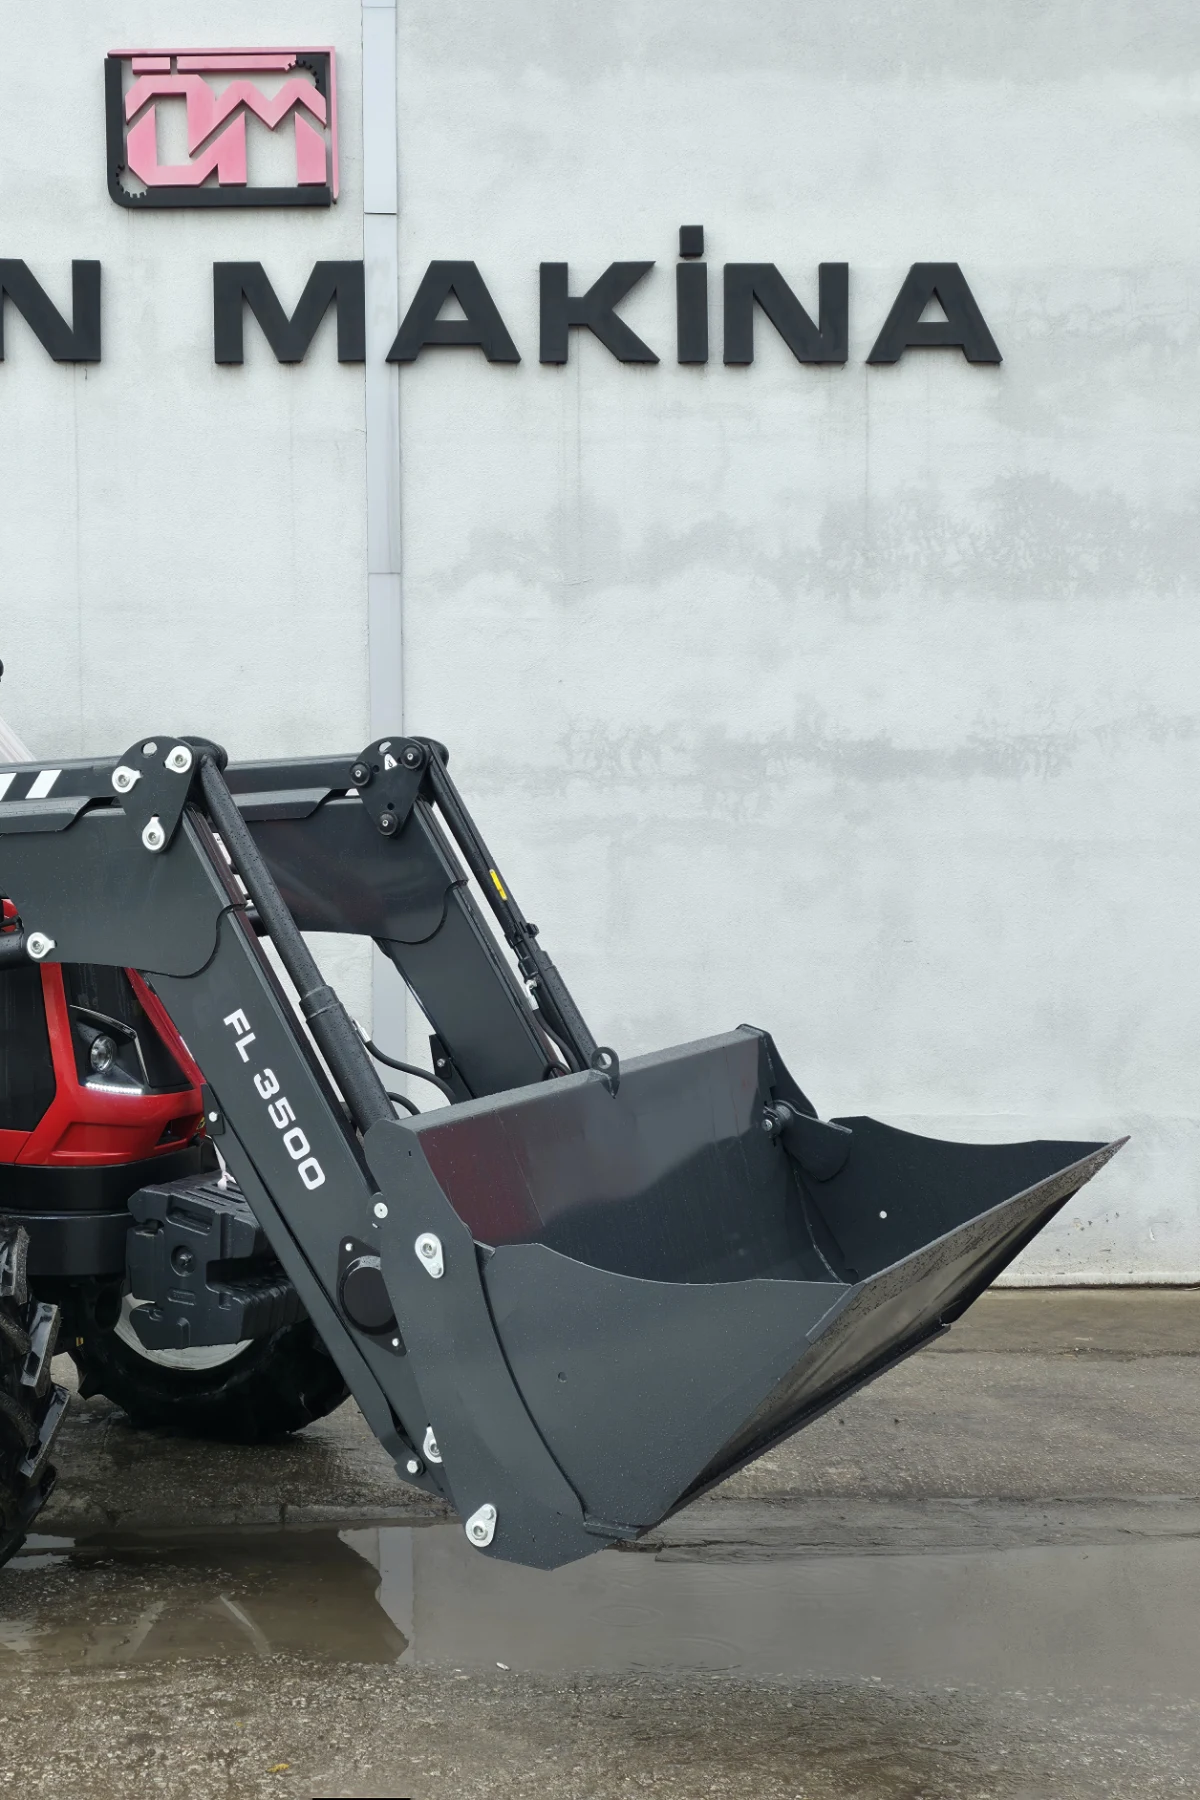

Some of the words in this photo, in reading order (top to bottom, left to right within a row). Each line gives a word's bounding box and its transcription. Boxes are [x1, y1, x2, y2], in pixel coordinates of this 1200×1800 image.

[212, 224, 1004, 365] MAKİNA
[222, 1008, 256, 1063] FL
[253, 1068, 326, 1191] 3500
